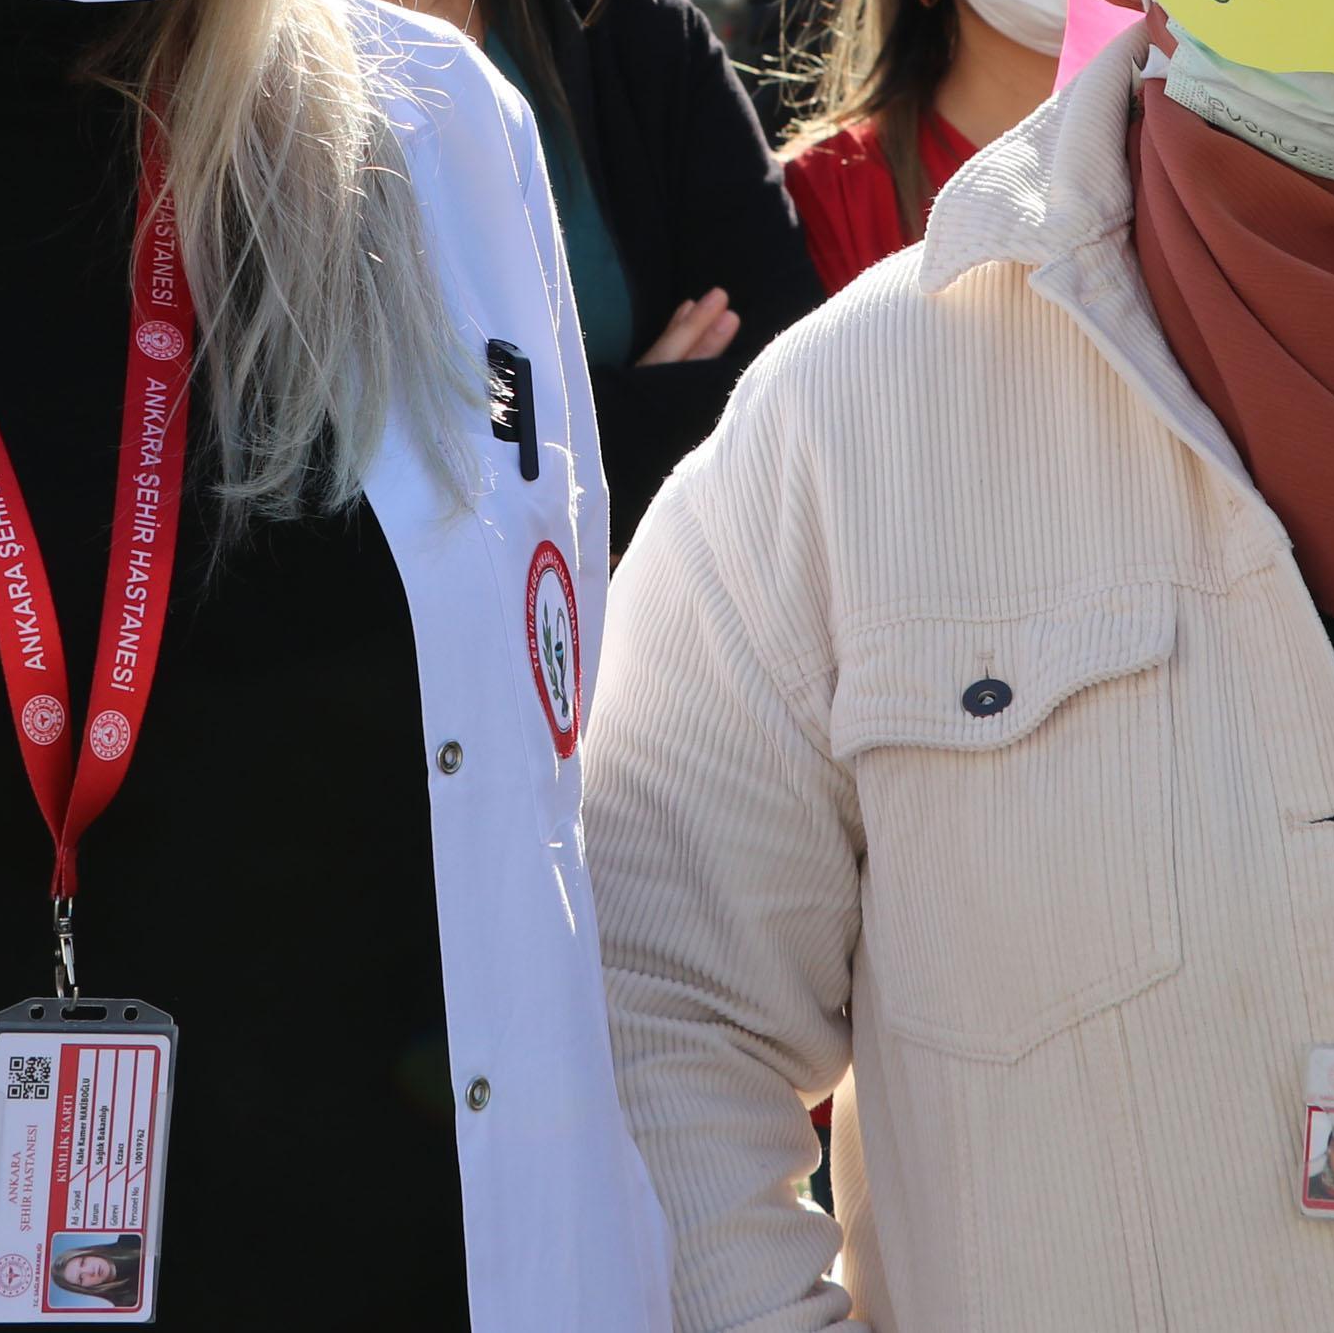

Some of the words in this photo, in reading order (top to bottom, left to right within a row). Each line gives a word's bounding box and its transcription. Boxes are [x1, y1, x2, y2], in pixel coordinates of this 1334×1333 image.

[139, 376, 167, 467] ANKARA
[132, 472, 162, 544] ŞEHİR
[3, 562, 47, 671] ANKARA
[110, 548, 153, 693] HASTANESİ
[61, 1095, 73, 1133] KARTI
[97, 1105, 109, 1141] Bakanlığı
[78, 1122, 87, 1146] Kamer
[135, 1129, 145, 1165] 10019762
[23, 1125, 38, 1193] HASTANESİ
[56, 1136, 70, 1183] KİMLİK
[76, 1148, 85, 1165] Hale
[95, 1142, 106, 1165] Sağlık
[9, 1151, 21, 1204] ANKARA
[131, 1186, 140, 1197] No
[20, 1195, 32, 1233] ŞEHİR
[72, 1190, 82, 1211] Soyad
[91, 1203, 100, 1226] Kurum
[129, 1197, 139, 1226] Personel
